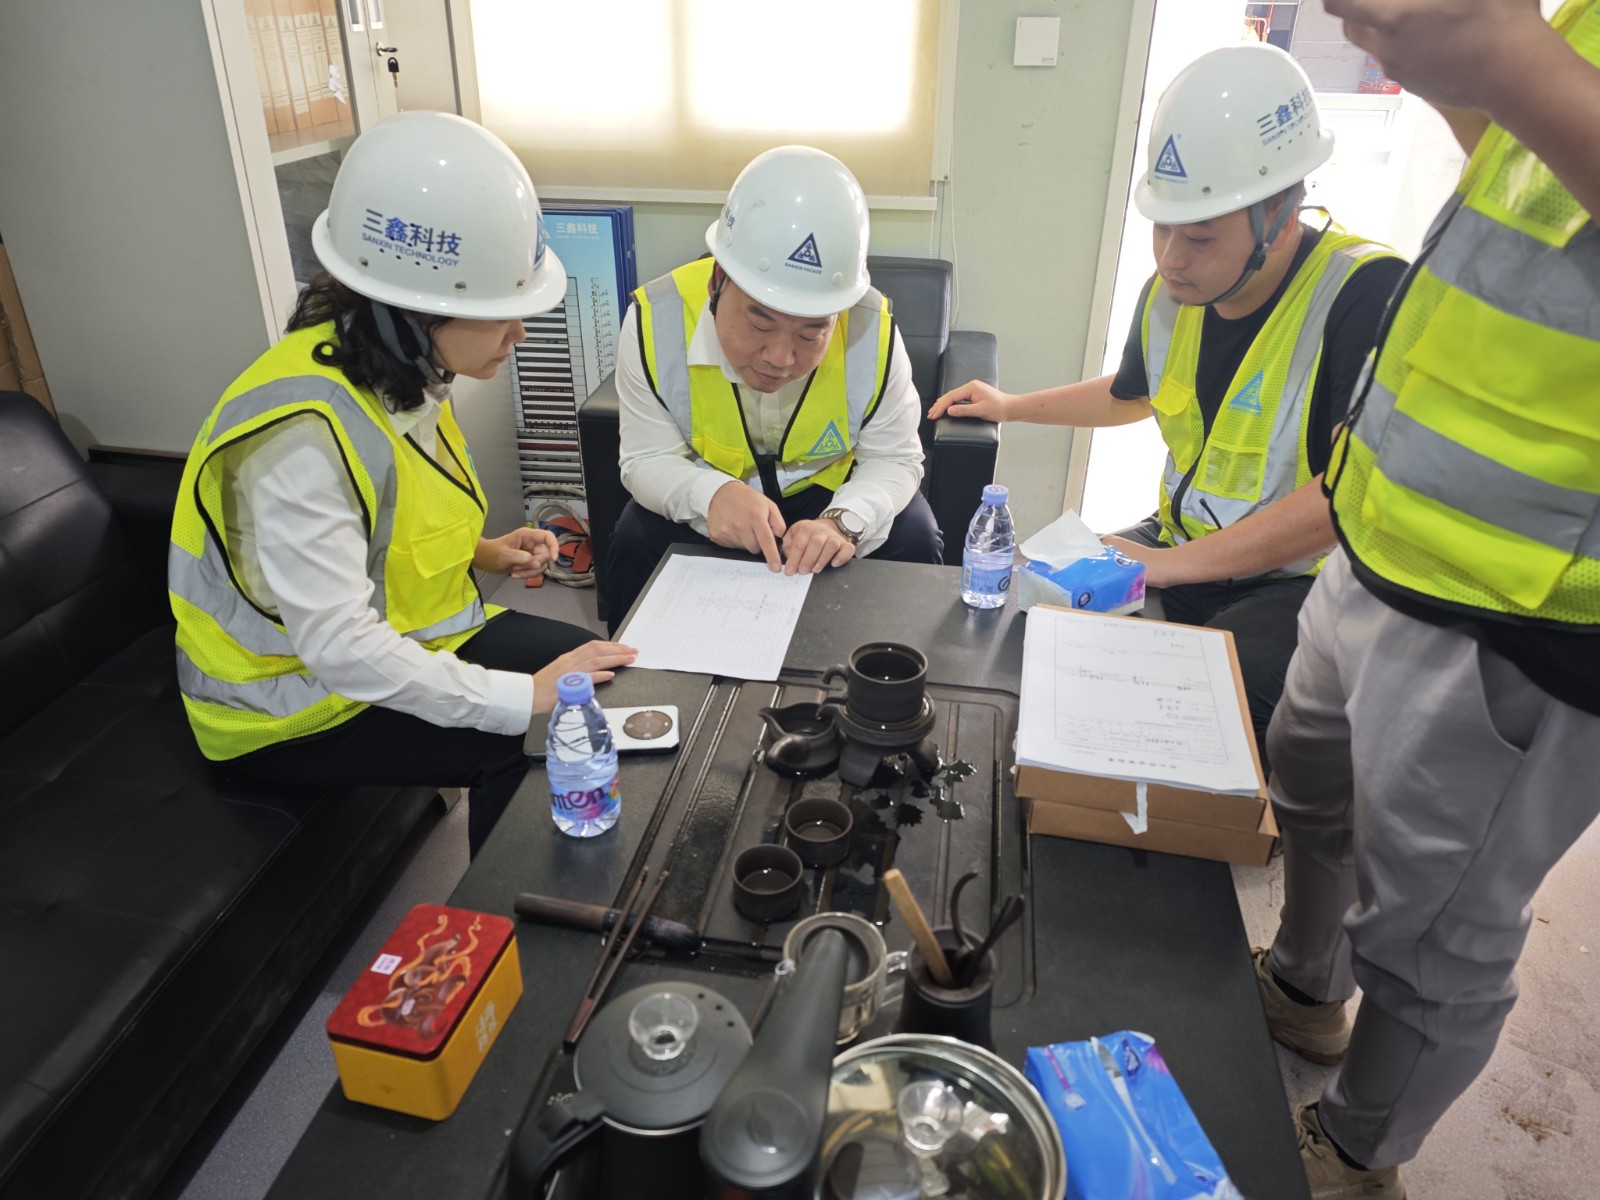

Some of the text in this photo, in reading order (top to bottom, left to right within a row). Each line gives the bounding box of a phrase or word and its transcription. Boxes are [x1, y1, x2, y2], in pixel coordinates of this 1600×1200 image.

[362, 208, 462, 256] 三鑫科技
[555, 221, 599, 235] 三鑫科技
[361, 232, 460, 267] SANXIN TECHNOLOGY
